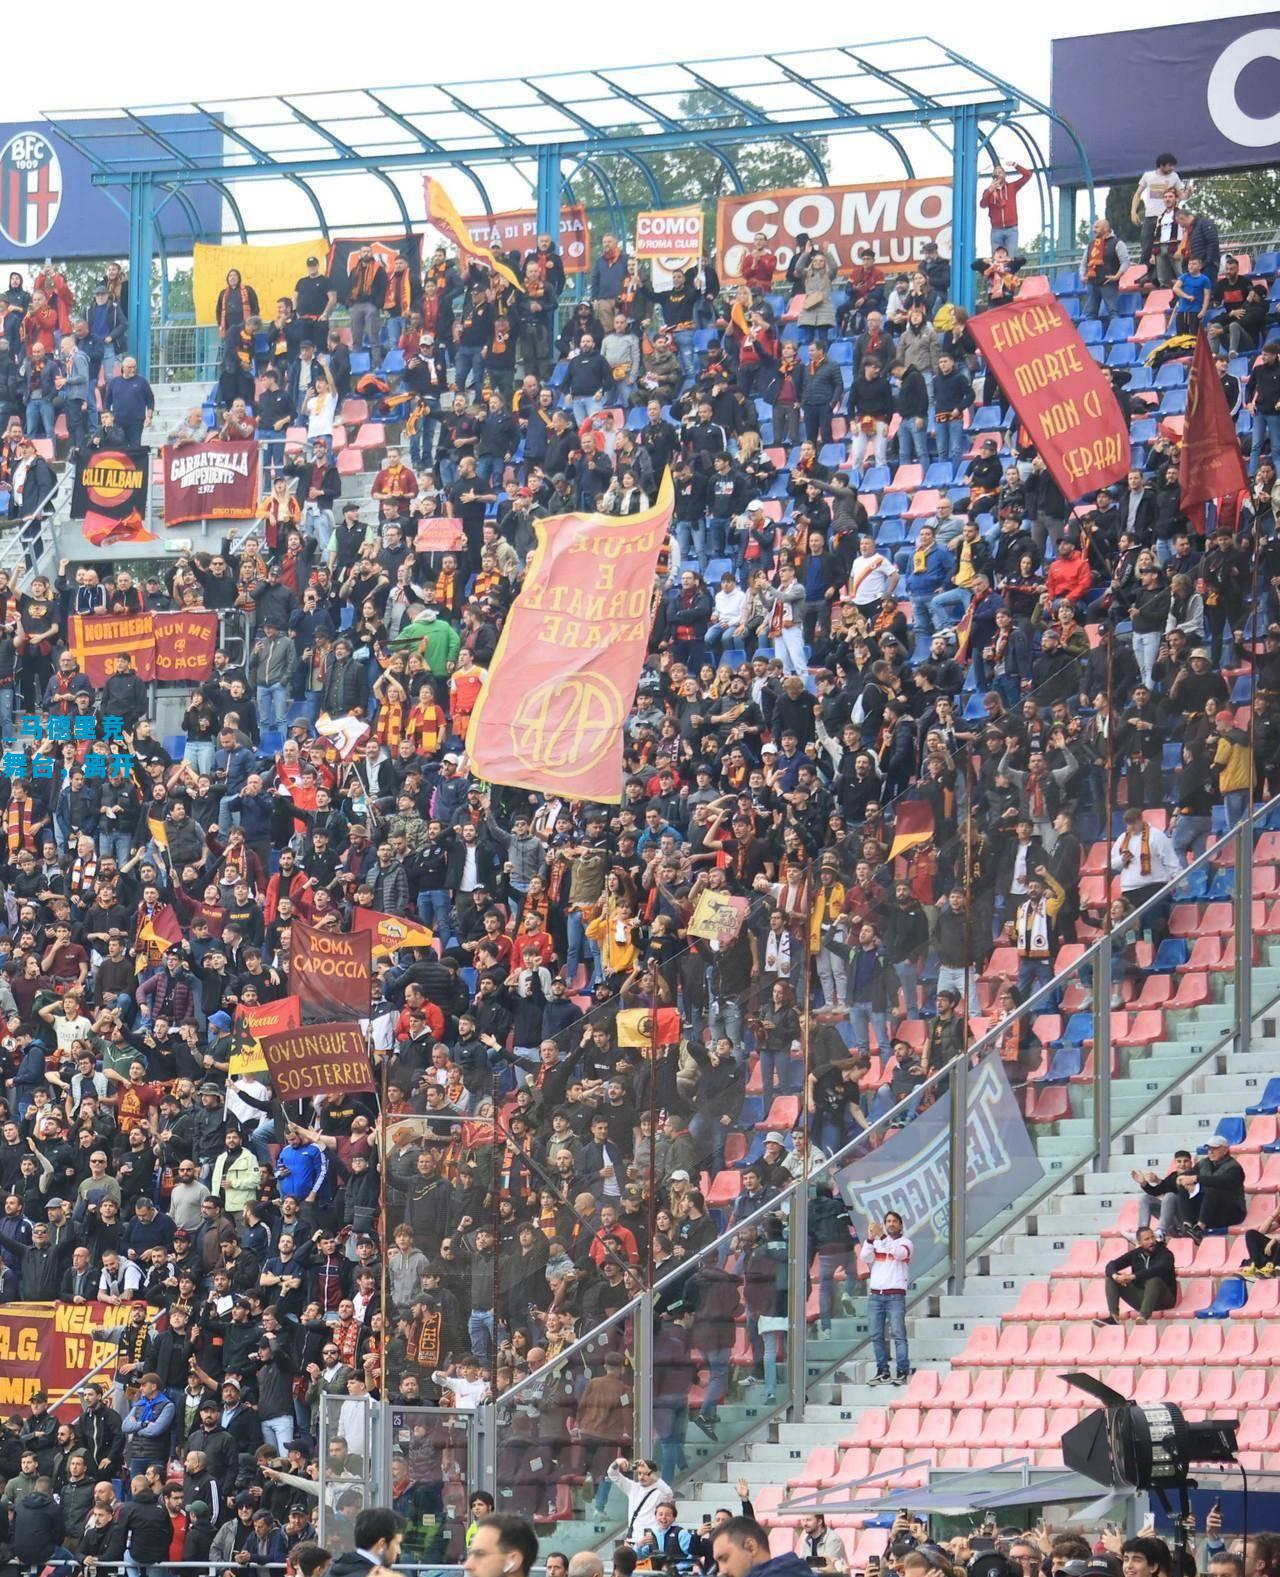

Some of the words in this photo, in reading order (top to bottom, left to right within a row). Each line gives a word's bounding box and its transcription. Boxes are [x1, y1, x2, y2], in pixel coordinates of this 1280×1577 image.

[11, 136, 44, 161] BFC
[16, 158, 39, 170] 1909
[638, 218, 699, 234] COMO
[732, 185, 952, 243] COMO
[504, 224, 518, 239] DI
[646, 238, 673, 249] ROMA
[675, 238, 698, 249] CLUB
[851, 235, 932, 265] CLUB
[1015, 344, 1084, 397] MORTE
[1039, 399, 1080, 441] NON
[1083, 390, 1102, 418] CI
[171, 452, 248, 482] GARBATELLA
[1063, 433, 1121, 482] SEPARI
[107, 469, 143, 488] ALBANI
[85, 616, 153, 641] NORTHERN
[155, 623, 184, 640] NUN
[188, 624, 211, 640] ME
[175, 654, 208, 669] PACE
[311, 935, 353, 955] ROMA
[293, 954, 368, 979] CAPOCCIA
[270, 1032, 346, 1064] OVUNQUE
[351, 1032, 363, 1054] TI
[55, 1305, 96, 1335] NEL
